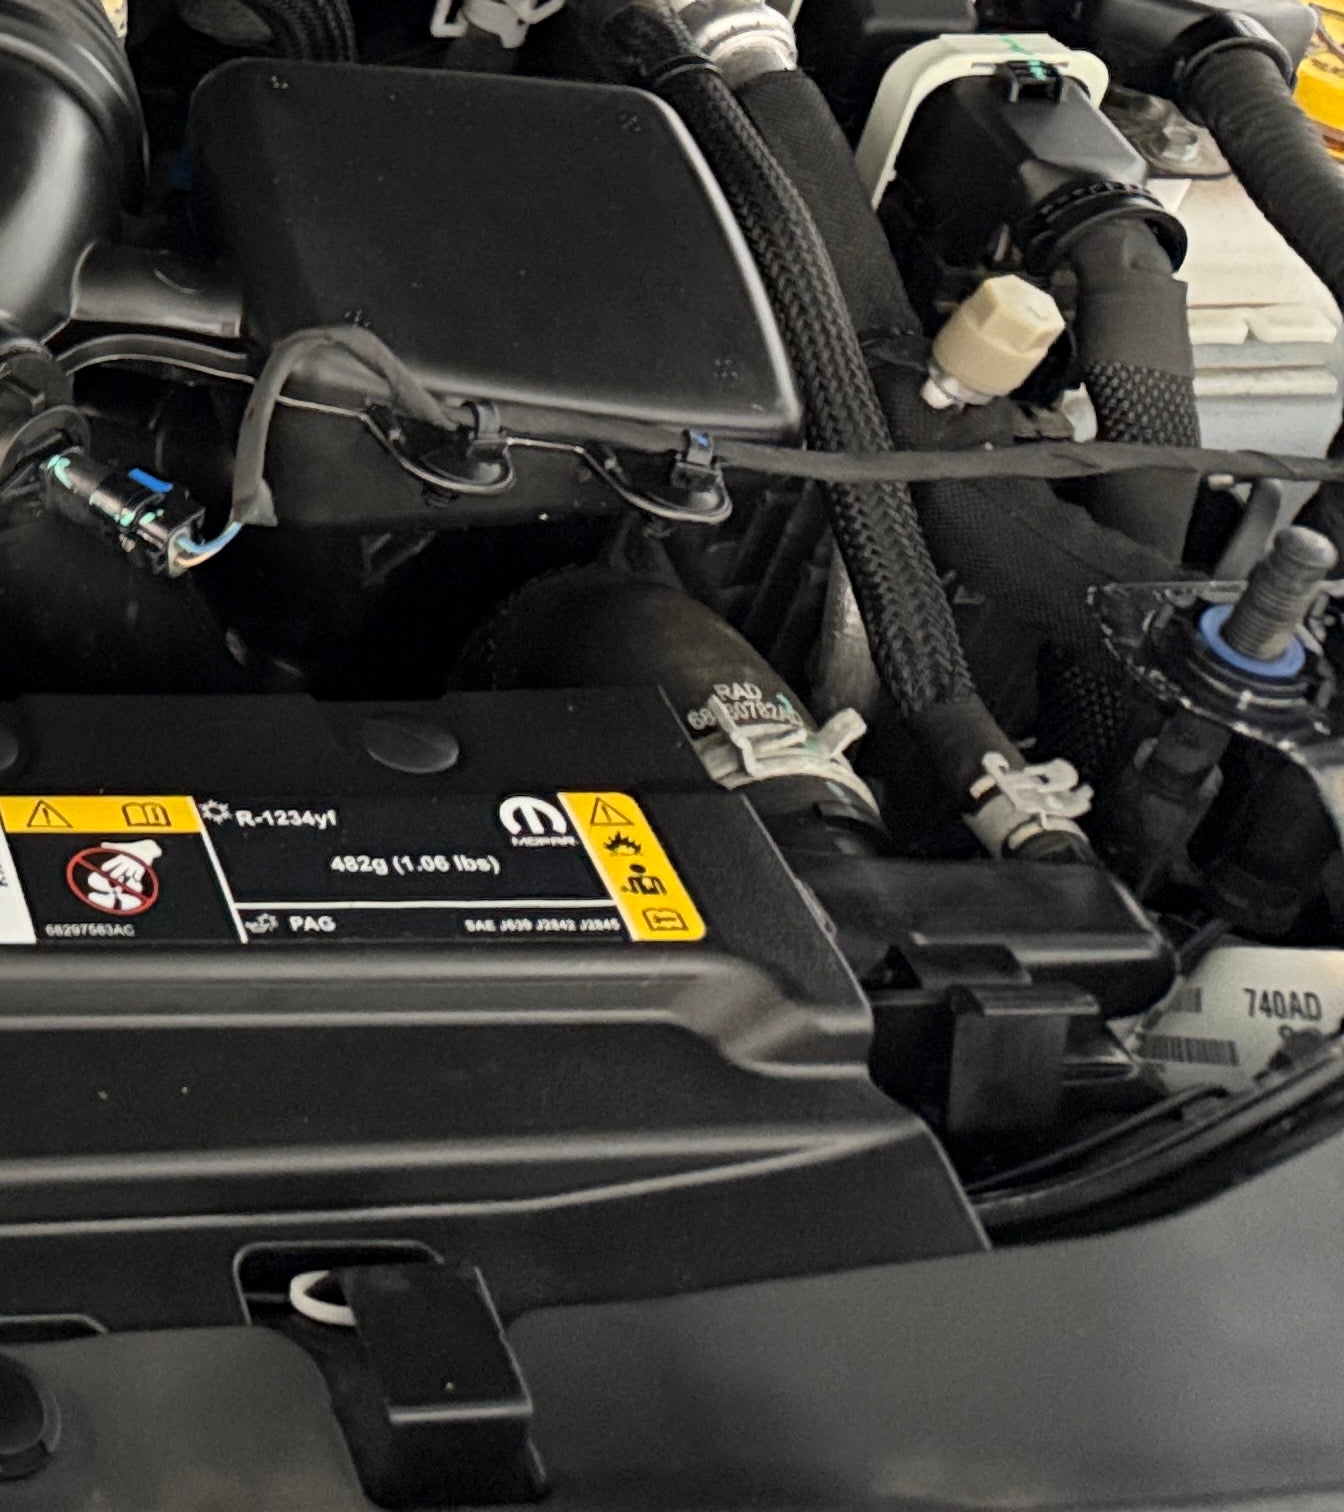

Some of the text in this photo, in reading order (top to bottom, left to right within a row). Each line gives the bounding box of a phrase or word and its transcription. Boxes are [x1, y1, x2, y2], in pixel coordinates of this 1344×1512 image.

[713, 681, 763, 701] RAD
[234, 809, 338, 831] R-1234yf
[330, 854, 501, 876] 482g (1.06 lbs)
[287, 915, 337, 932] PAG
[464, 918, 497, 932] SAE
[1242, 987, 1323, 1021] 740AD
